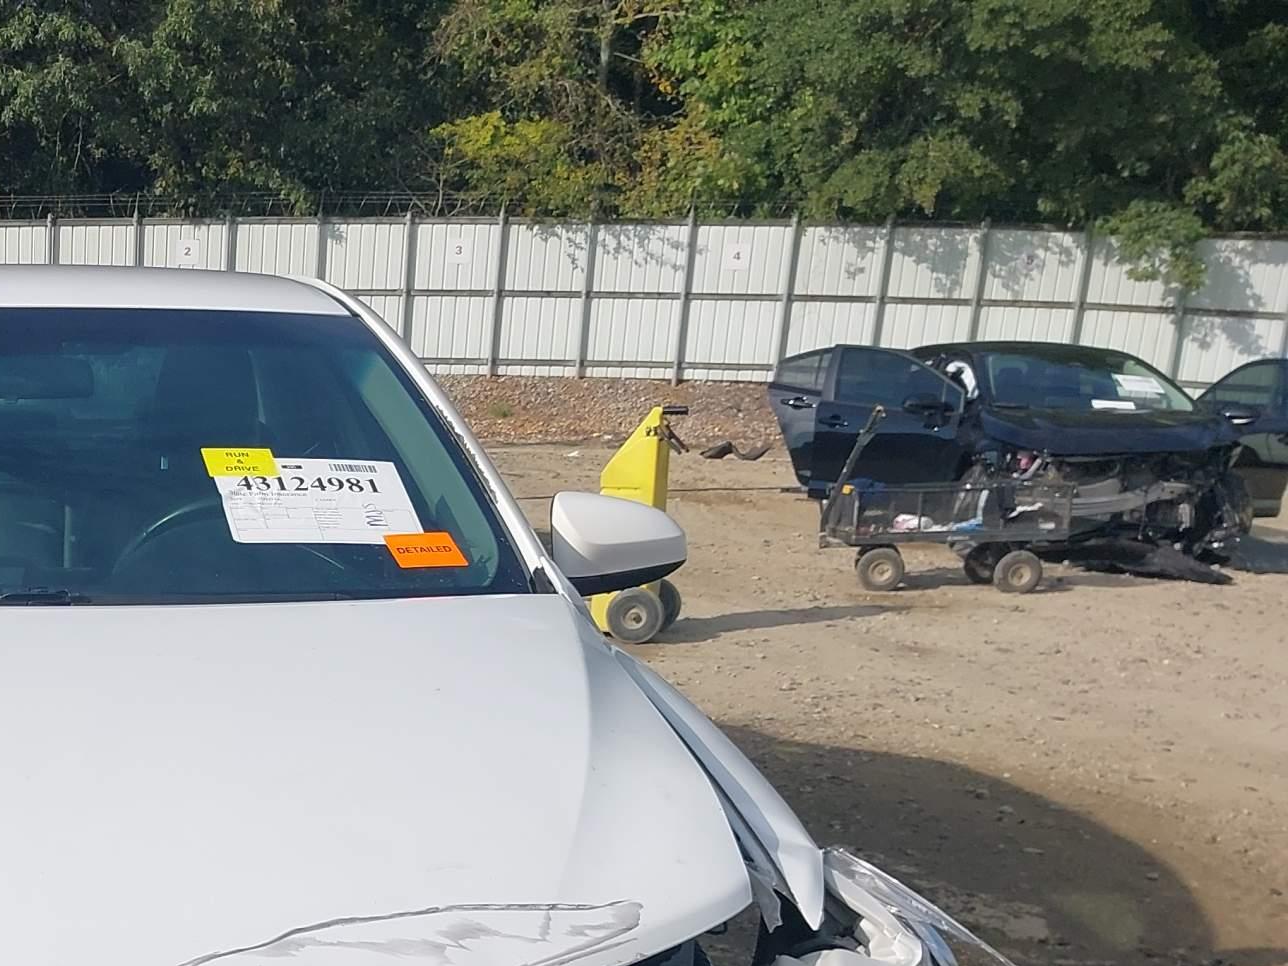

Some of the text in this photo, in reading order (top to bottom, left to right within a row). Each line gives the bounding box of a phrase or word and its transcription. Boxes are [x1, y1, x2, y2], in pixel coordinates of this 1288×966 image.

[184, 247, 191, 256] 2
[455, 246, 463, 255] 3
[732, 251, 740, 260] 4
[237, 475, 382, 493] 43124981
[396, 545, 453, 555] DETAILED
